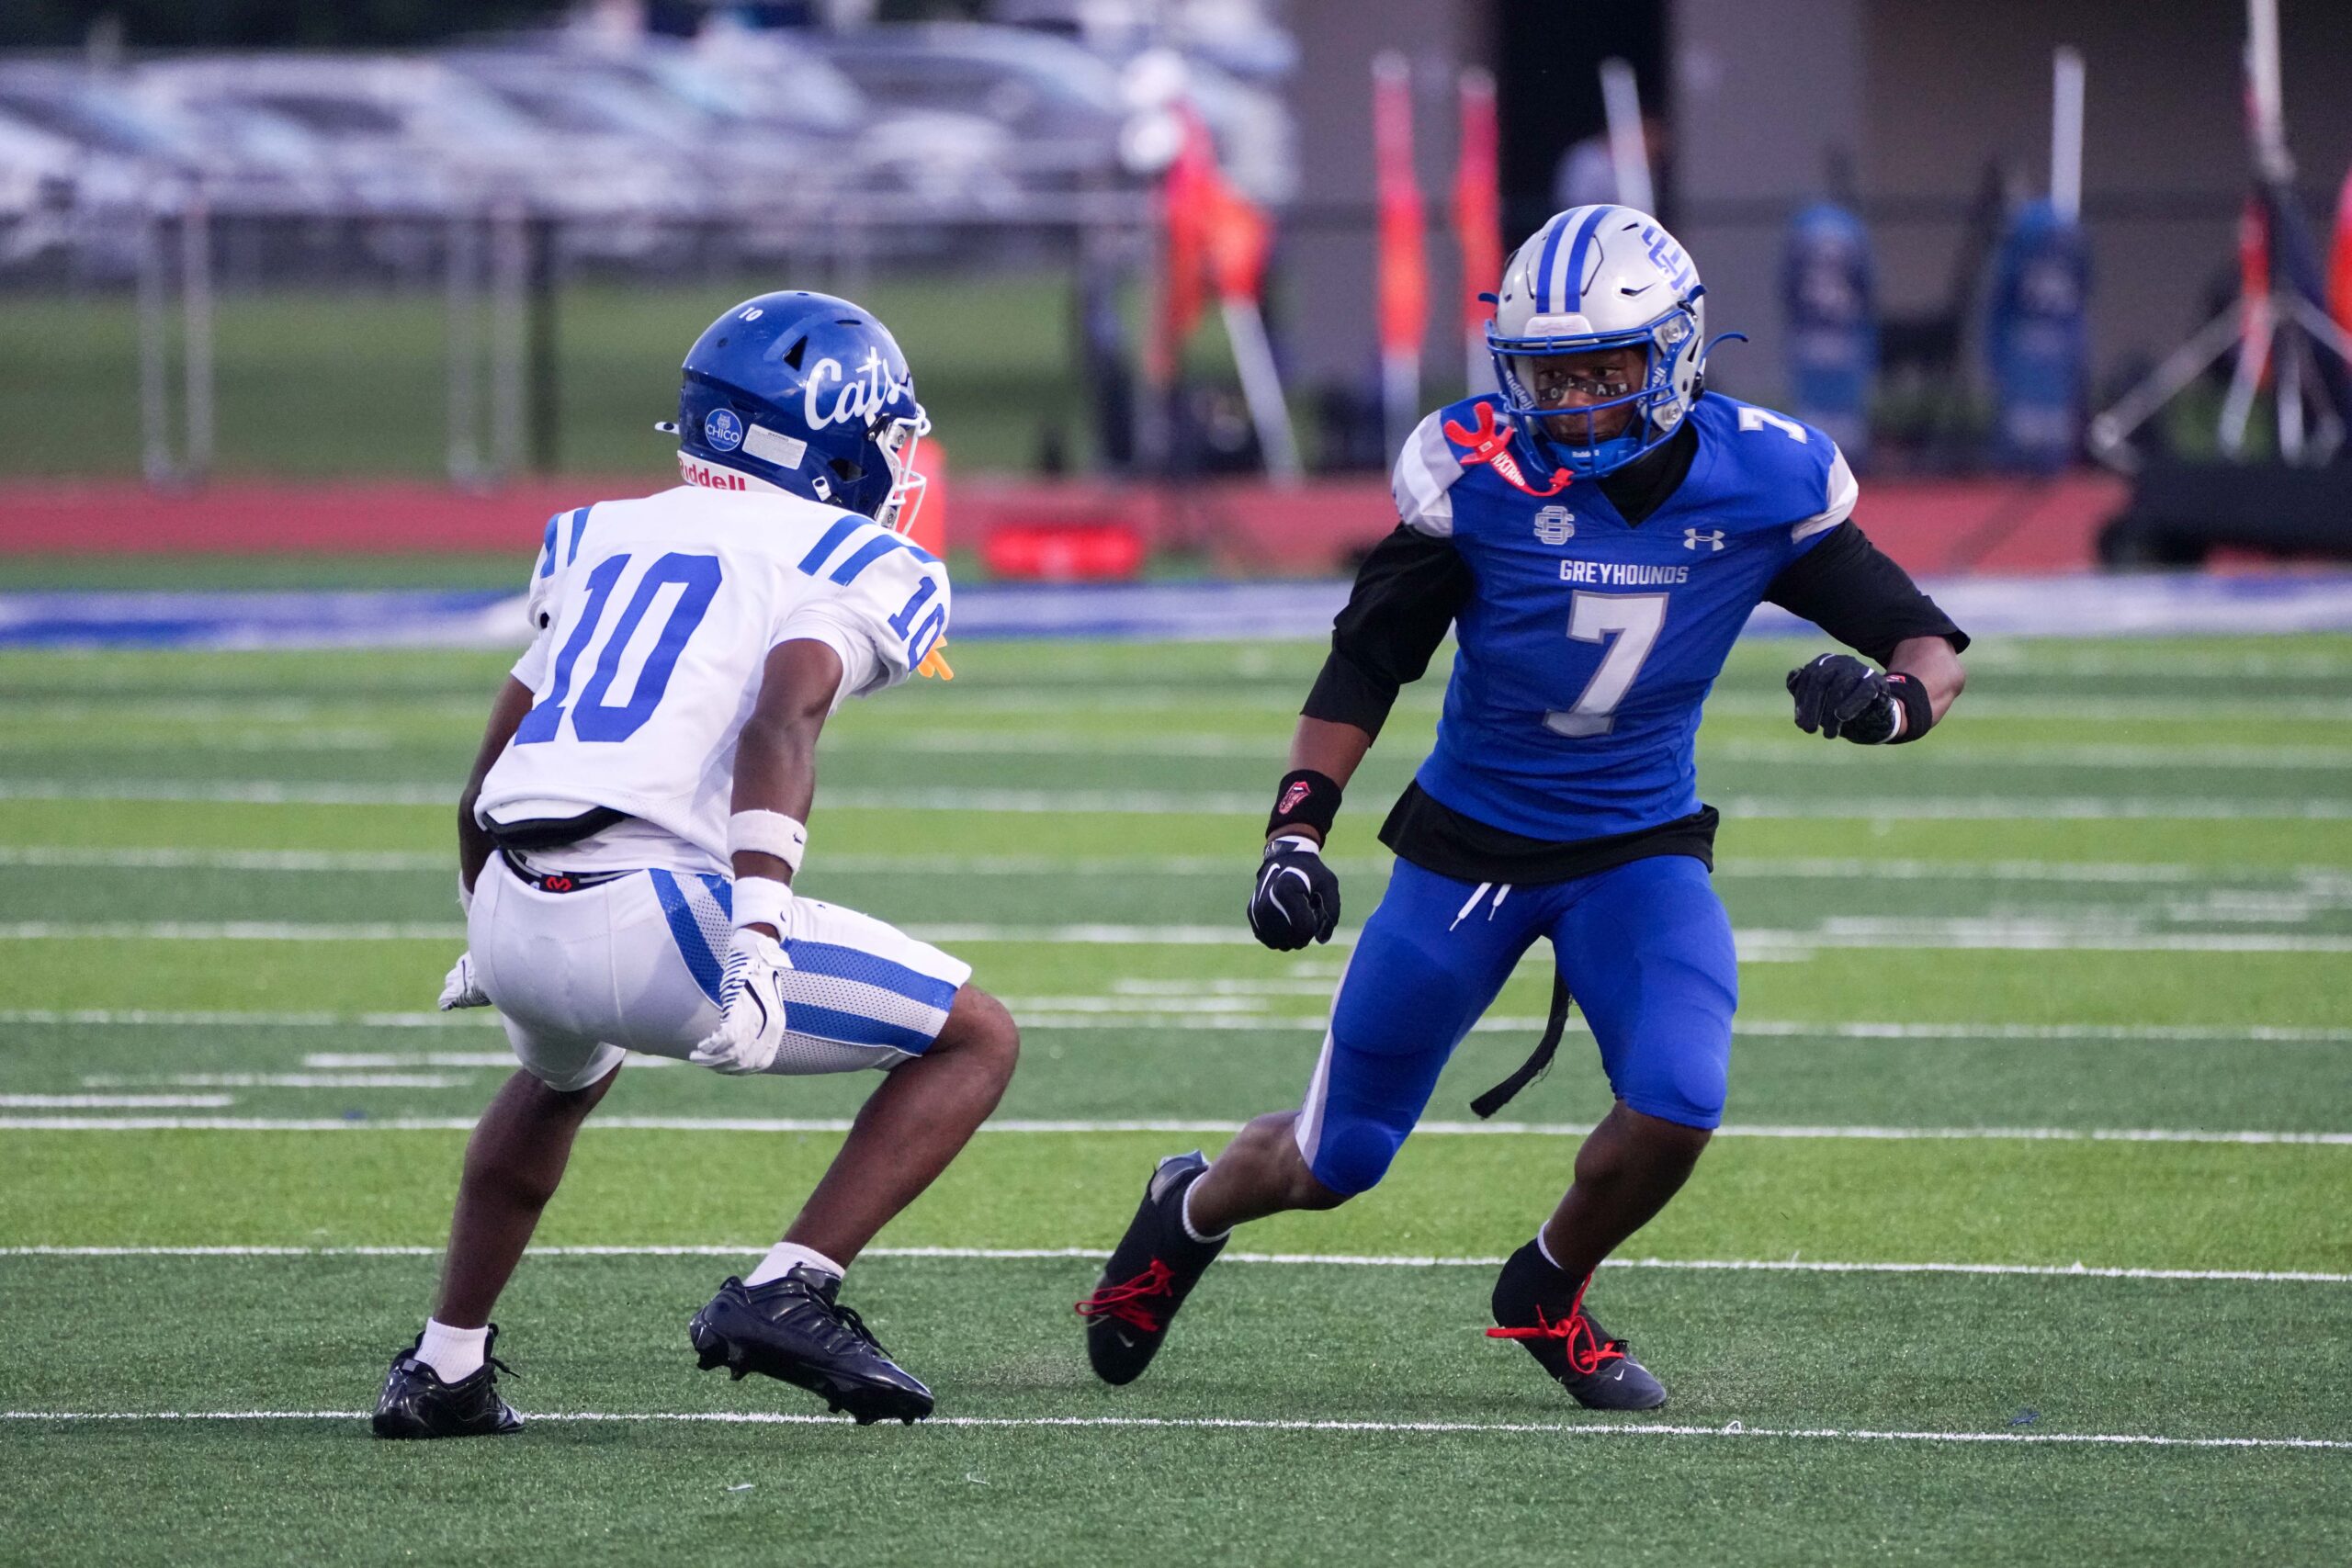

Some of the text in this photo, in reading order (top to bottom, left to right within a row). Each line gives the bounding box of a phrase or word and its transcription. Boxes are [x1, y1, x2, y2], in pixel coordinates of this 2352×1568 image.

[739, 307, 763, 321] 10
[804, 346, 912, 431] Cats
[707, 424, 739, 442] CHICO
[1738, 406, 1807, 444] 7
[1559, 559, 1690, 585] GREYHOUNDS
[514, 552, 722, 746] 10
[888, 576, 944, 672] 10
[1542, 590, 1670, 736] 7
